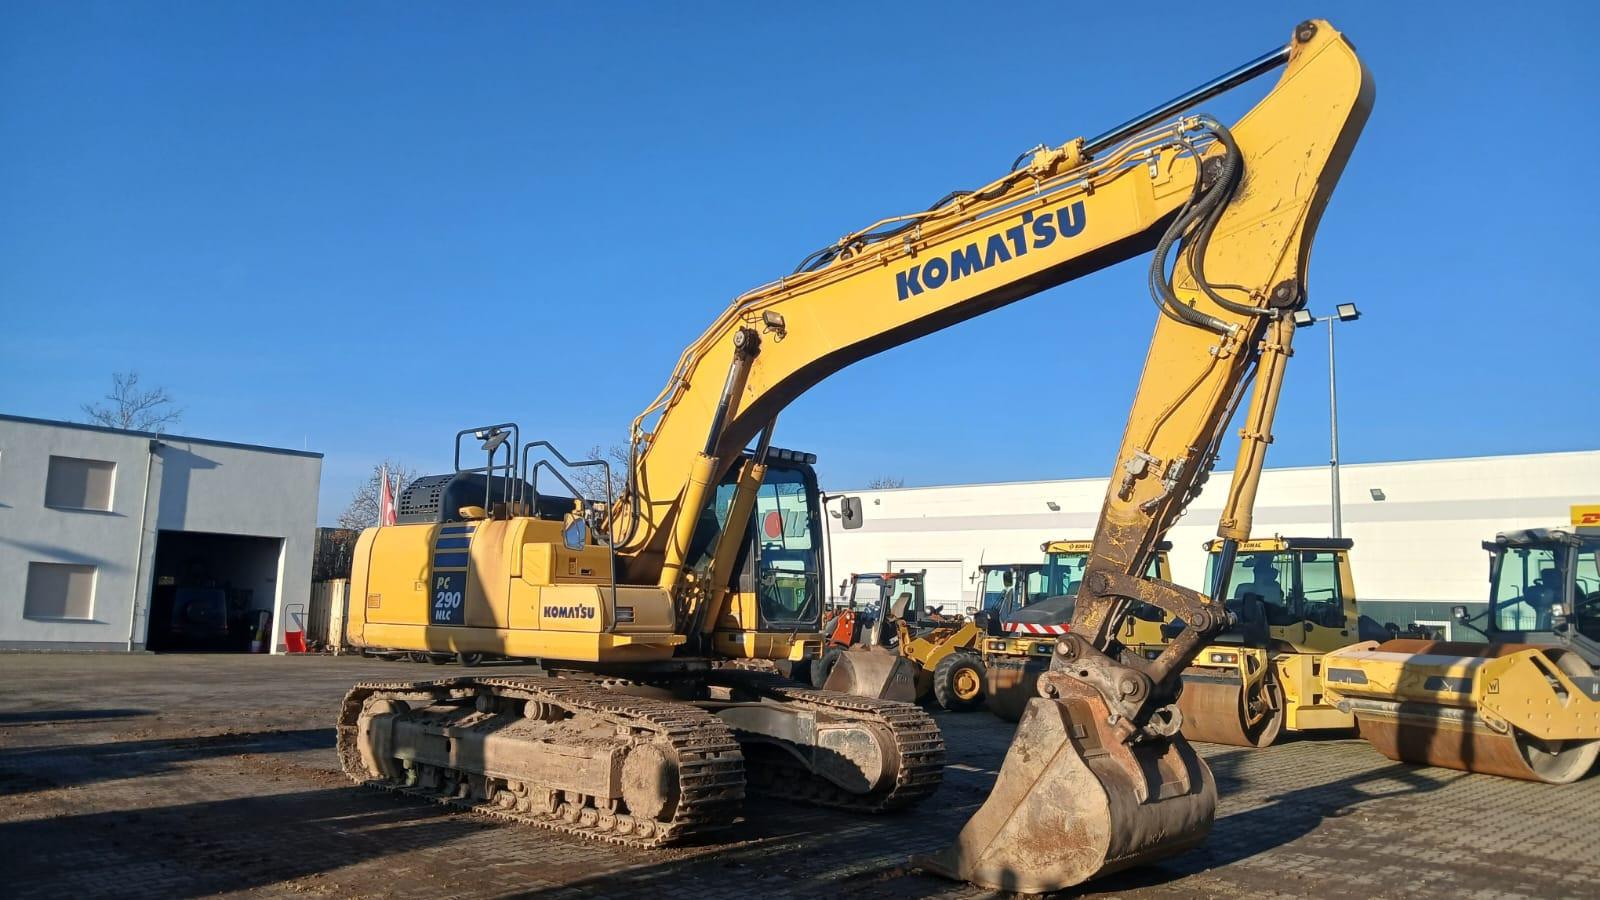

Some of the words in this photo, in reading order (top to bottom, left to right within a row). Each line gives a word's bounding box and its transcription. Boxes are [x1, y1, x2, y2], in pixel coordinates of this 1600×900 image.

[896, 200, 1086, 301] KOMATSU
[436, 577, 450, 589] PC
[435, 592, 461, 608] 290
[435, 610, 451, 621] NLC
[543, 603, 595, 619] KOMATSU
